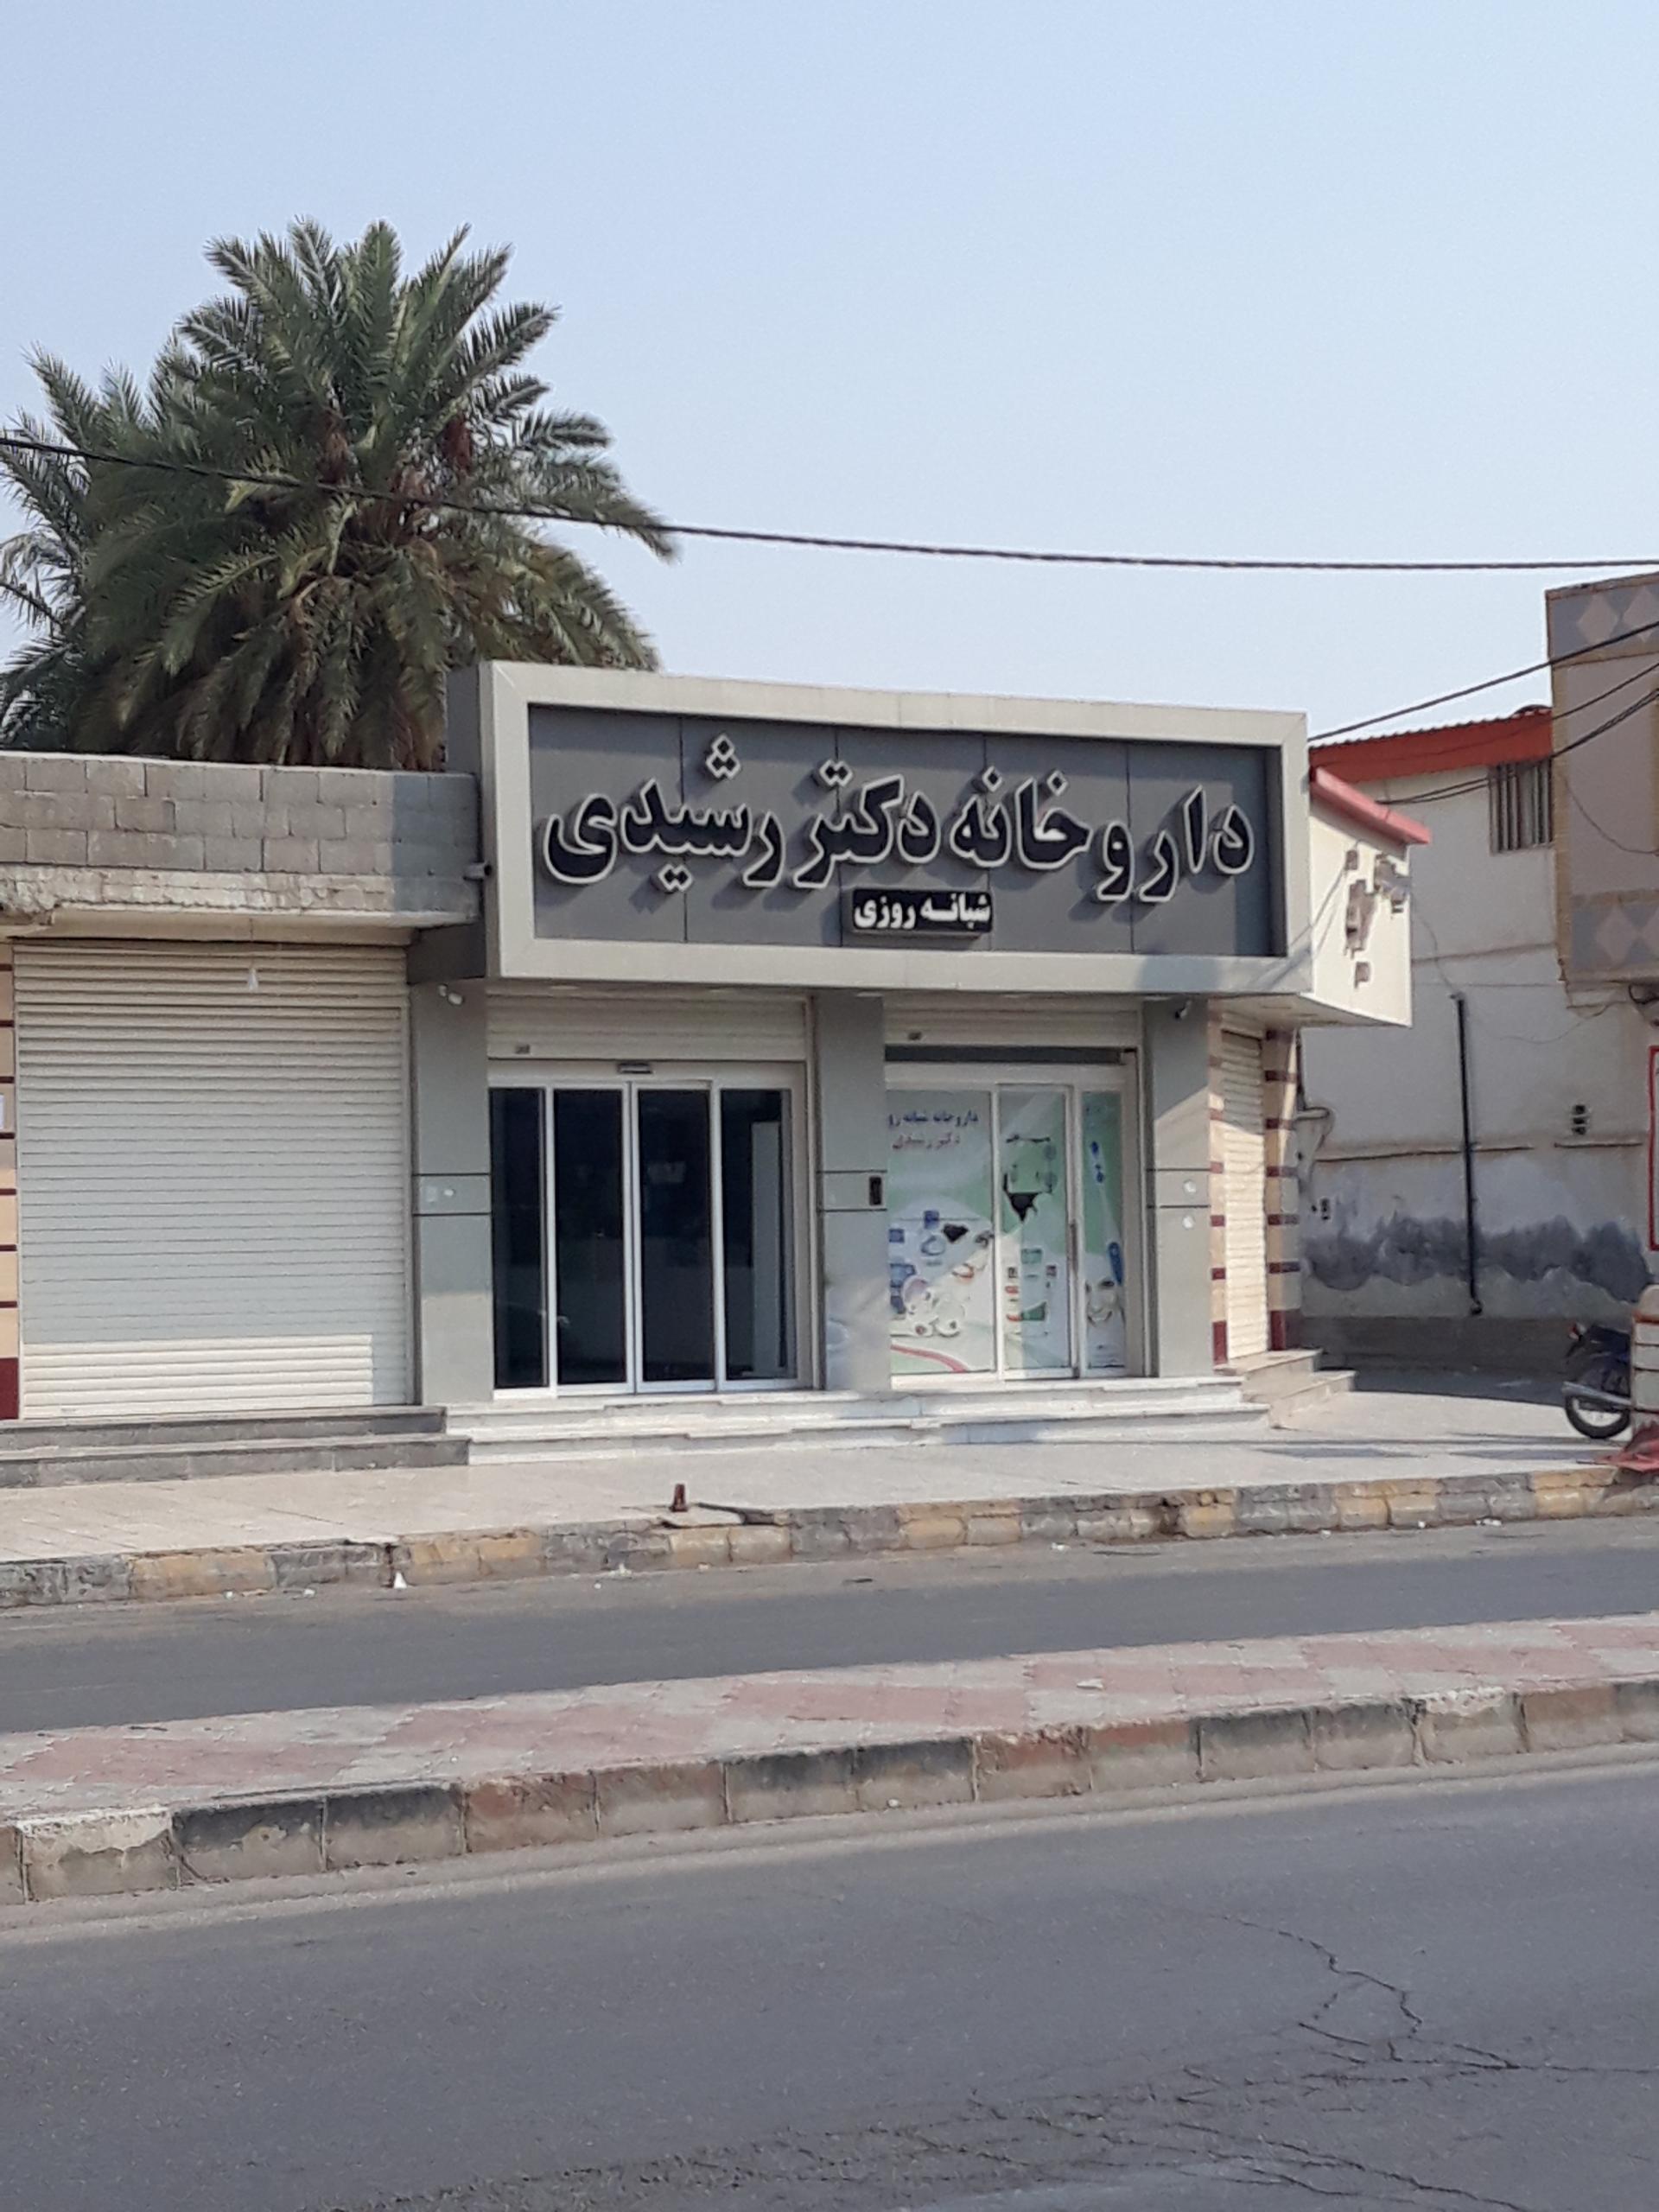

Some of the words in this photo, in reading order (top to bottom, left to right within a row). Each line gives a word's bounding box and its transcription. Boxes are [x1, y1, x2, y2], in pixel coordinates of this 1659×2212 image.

[543, 732, 786, 892] رشیدی
[792, 758, 941, 889] دکتر
[950, 766, 1255, 903] داروخانه
[854, 895, 917, 930] روزی
[920, 891, 991, 930] شبانه
